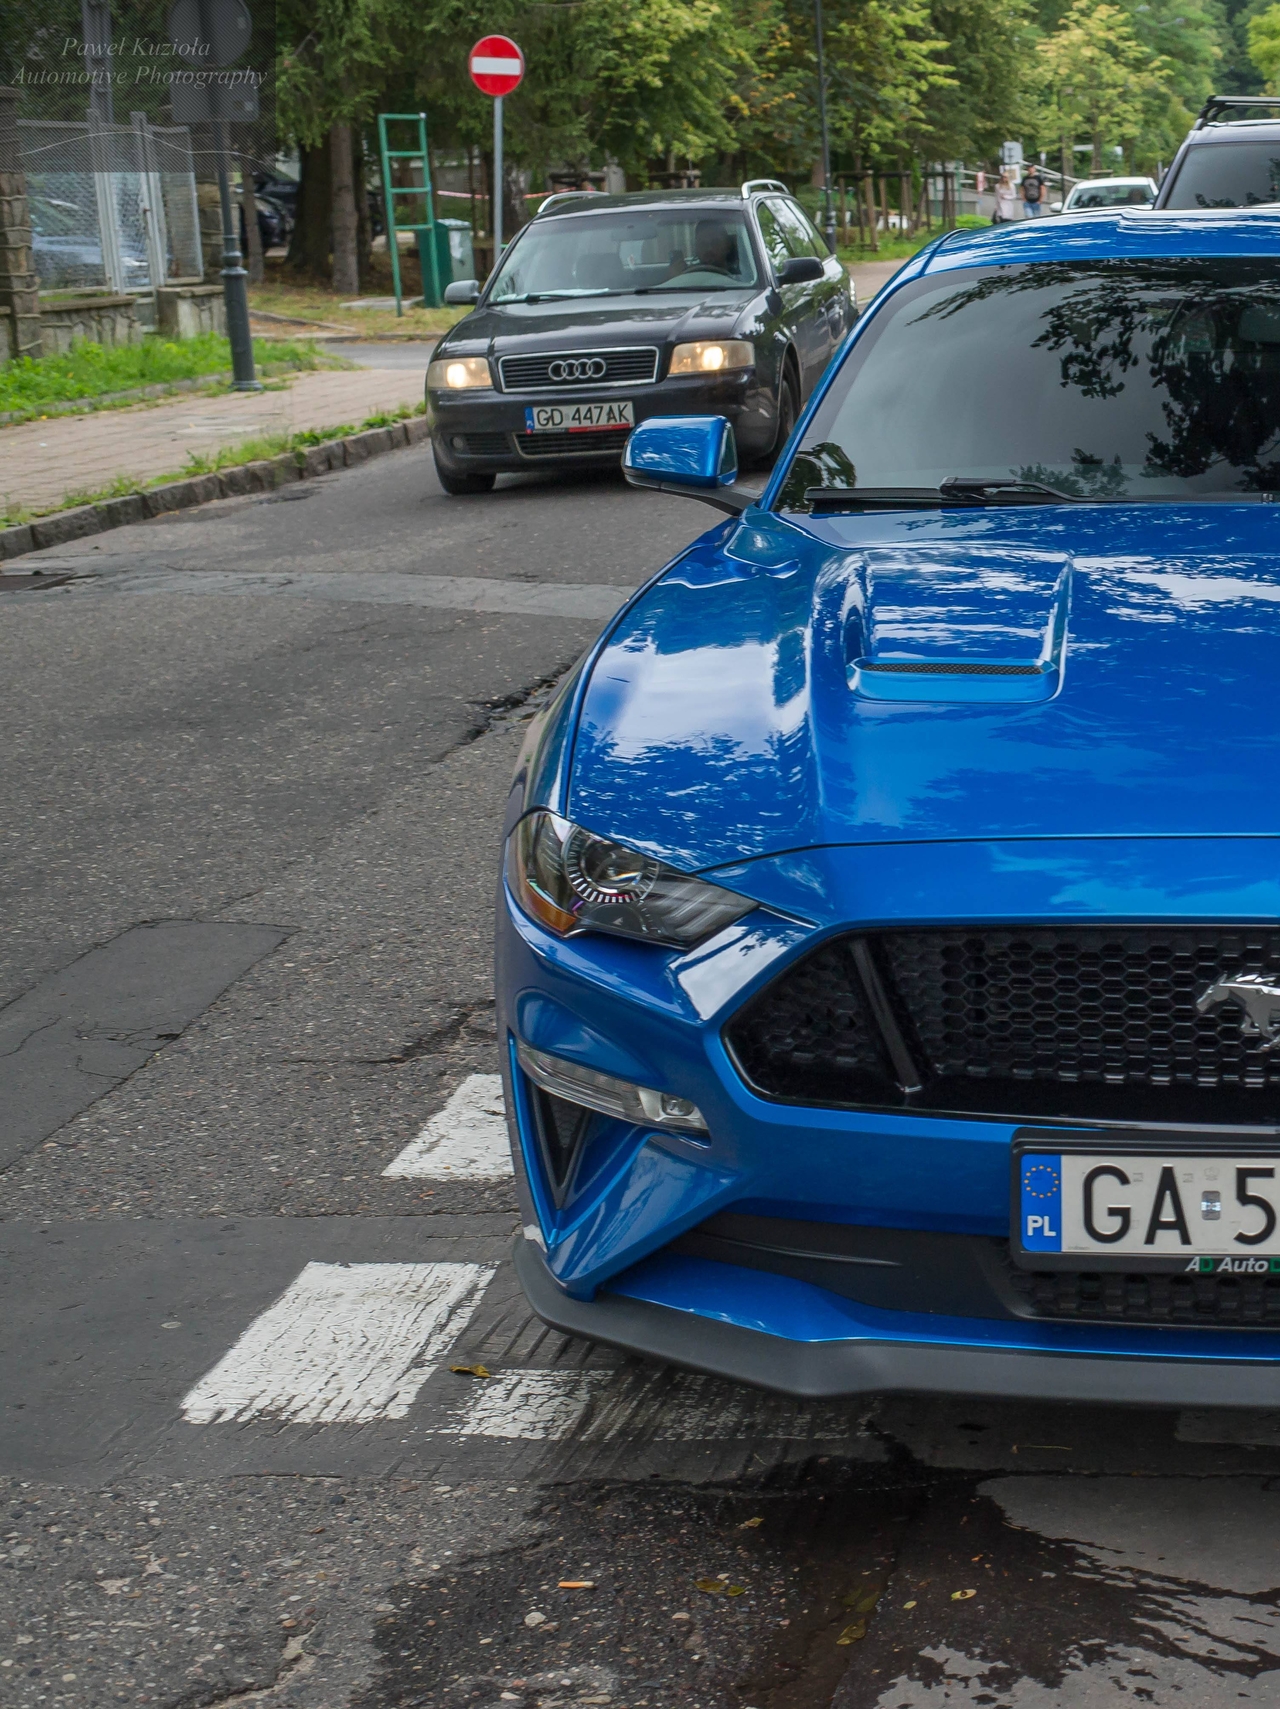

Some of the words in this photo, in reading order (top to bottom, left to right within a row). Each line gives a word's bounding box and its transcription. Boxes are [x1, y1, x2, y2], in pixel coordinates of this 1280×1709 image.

[536, 408, 564, 427] GD
[571, 403, 630, 425] 447AK
[1082, 1162, 1192, 1245] GA
[1027, 1215, 1057, 1237] PL
